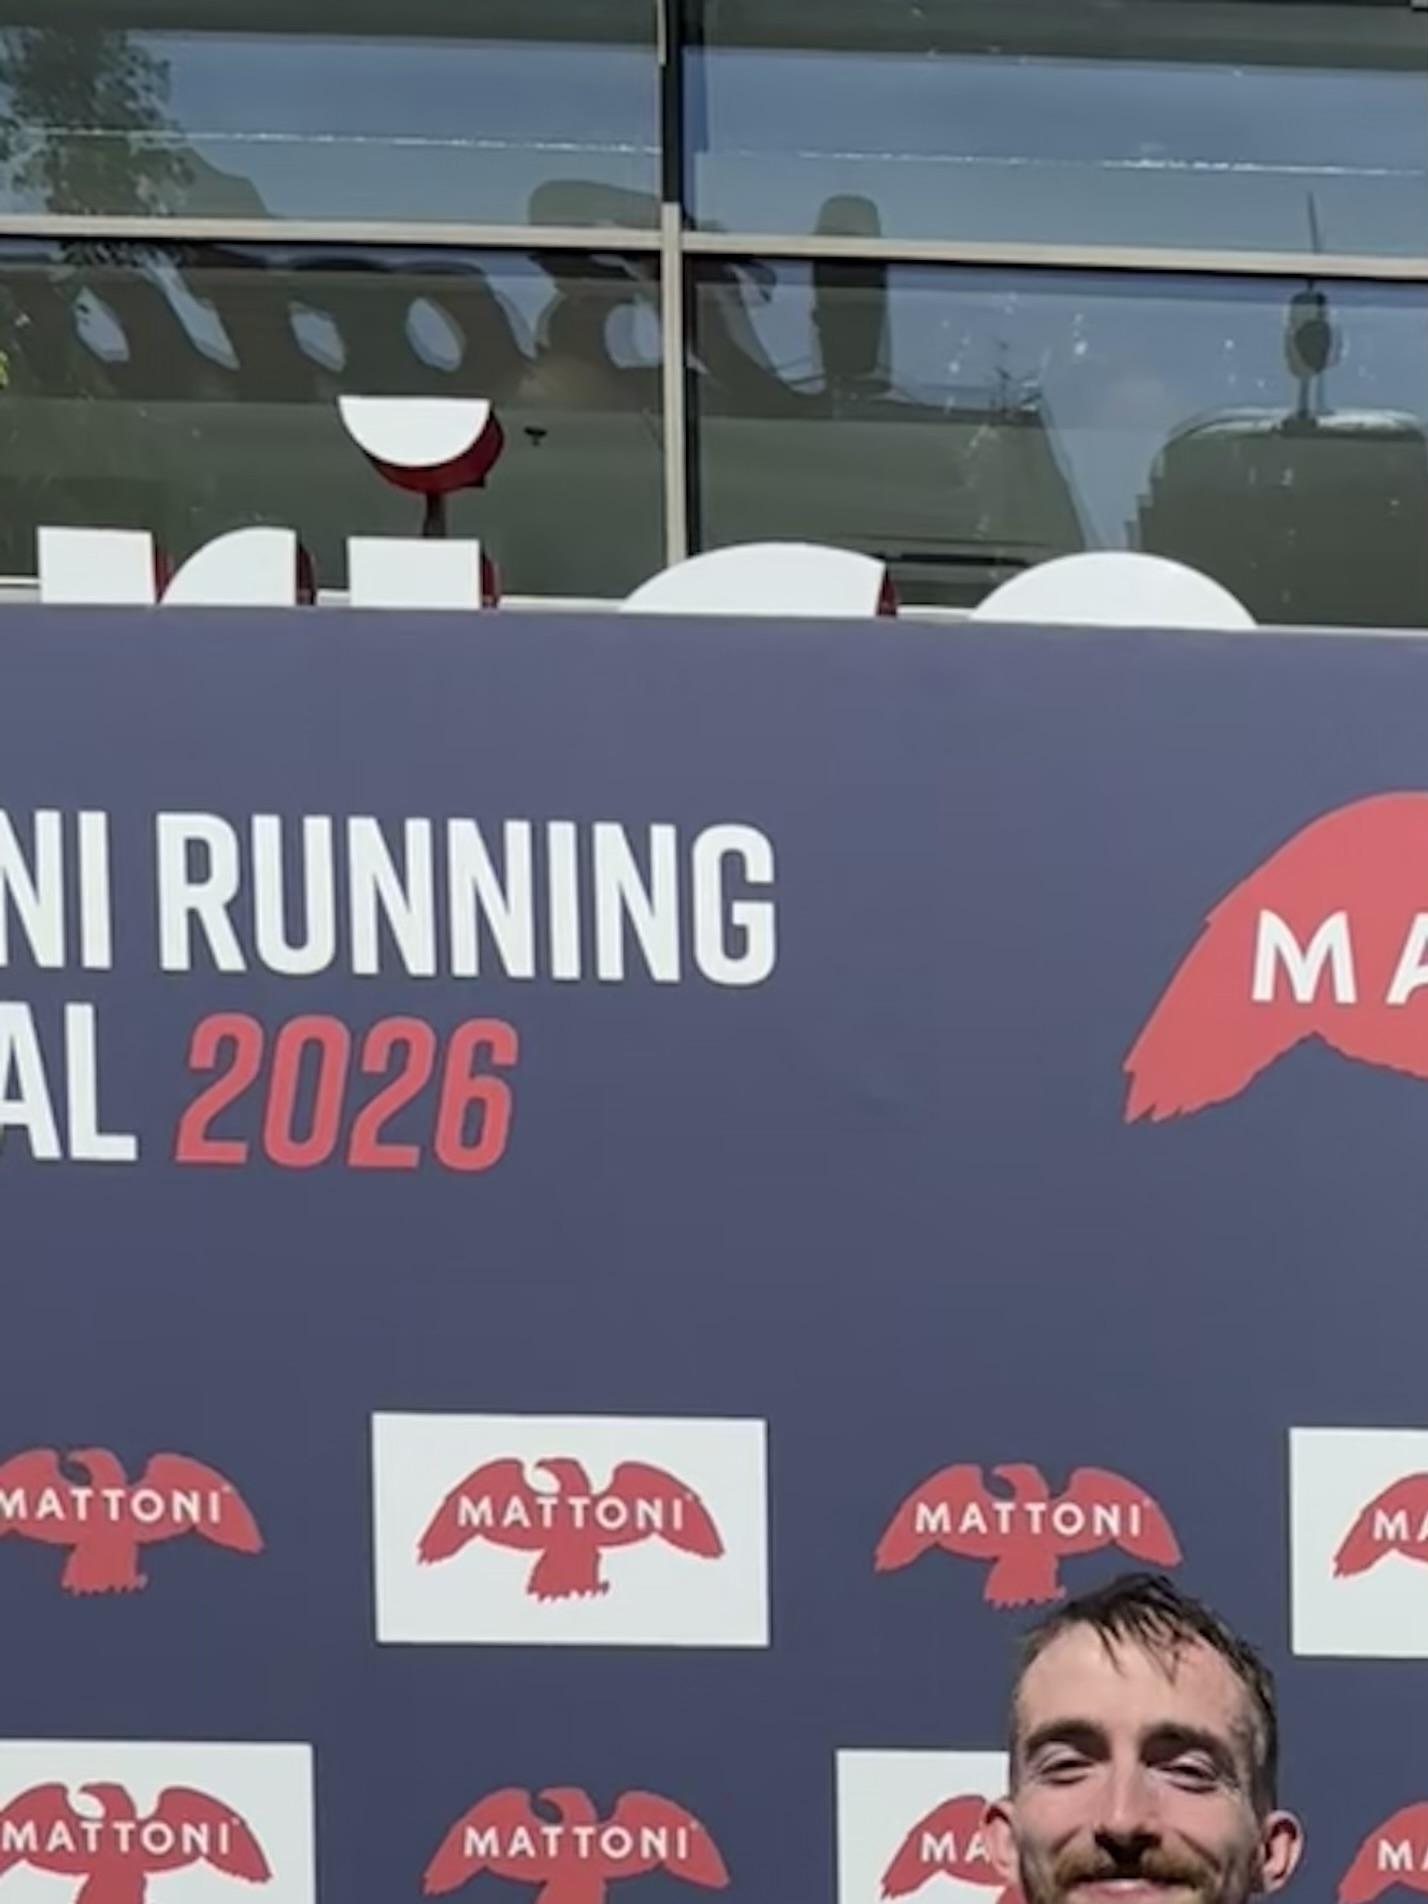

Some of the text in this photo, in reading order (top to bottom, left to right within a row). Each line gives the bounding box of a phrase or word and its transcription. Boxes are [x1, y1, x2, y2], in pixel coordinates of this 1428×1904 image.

[155, 811, 777, 987] RUNNING
[174, 1011, 520, 1171] 2026
[0, 1487, 219, 1523] MATTONI
[458, 1495, 682, 1529] MATTONI
[915, 1501, 1140, 1536] MATTONI
[2, 1820, 228, 1854] MATTONI
[464, 1825, 686, 1859] MATTONI
